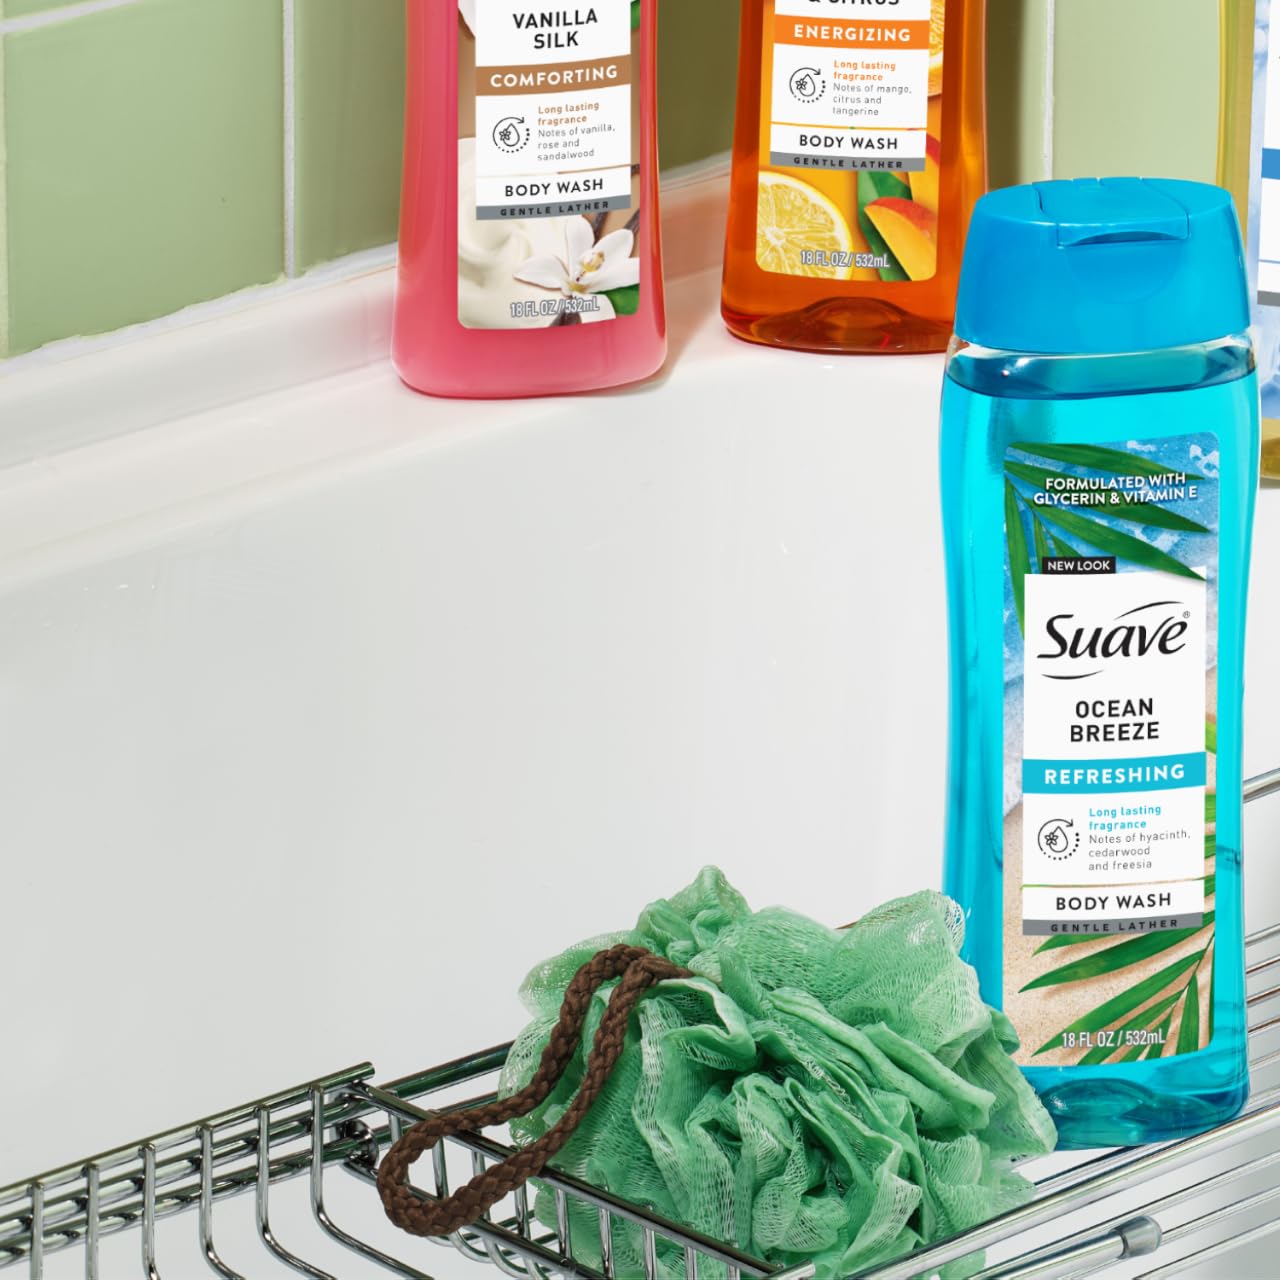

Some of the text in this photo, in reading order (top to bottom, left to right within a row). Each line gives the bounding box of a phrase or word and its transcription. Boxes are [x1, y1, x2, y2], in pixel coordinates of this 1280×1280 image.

[513, 8, 597, 29] VANILLA
[534, 31, 578, 49] SILK
[794, 24, 911, 41] ENERGIZING
[834, 60, 896, 71] Long lasting
[491, 65, 618, 87] COMFORTING
[834, 72, 883, 81] fragrance
[800, 135, 897, 149] BODY WASH
[794, 157, 902, 168] GENTLE LATHER
[505, 179, 603, 196] BODY WASH
[501, 202, 609, 216] GENTLE LATHER
[1046, 473, 1186, 491] FORMULATED WITH
[1034, 486, 1197, 505] GLYCERIN & VITAMIN E
[1048, 560, 1110, 571] NEW LOOK
[1037, 614, 1188, 659] Suave
[1076, 698, 1153, 718] OCEAN
[1070, 722, 1159, 742] BREEZE
[1045, 764, 1184, 785] REFRESHING
[1089, 805, 1161, 819] Long lasting
[1089, 819, 1147, 831] fragrance
[1089, 829, 1190, 844] Notes of hyacinth,
[1089, 846, 1150, 857] cedarwood
[1089, 860, 1152, 871] and freesia
[1057, 893, 1171, 910] BODY WASH
[1051, 919, 1177, 932] GENTLE LATHER
[1062, 1033, 1075, 1047] 18
[1080, 1033, 1093, 1046] FL
[1098, 1032, 1114, 1046] OZ
[1126, 1029, 1166, 1045] 532mL
